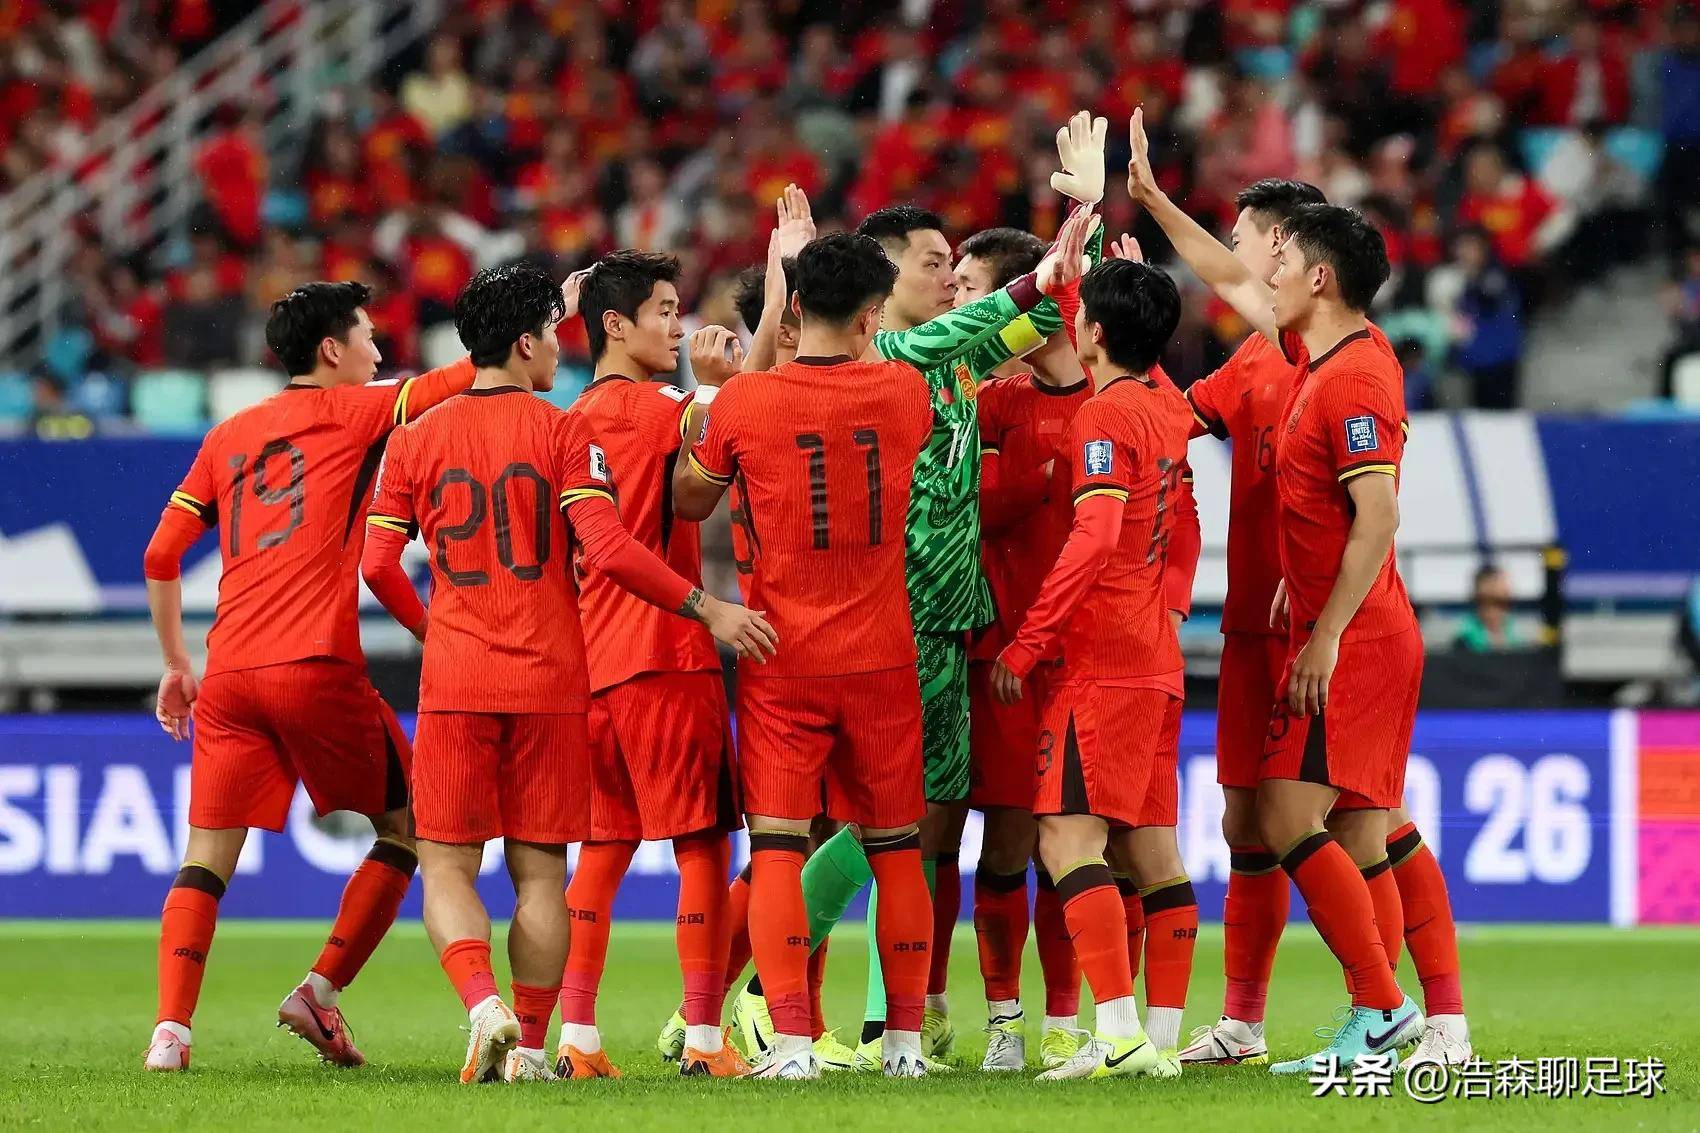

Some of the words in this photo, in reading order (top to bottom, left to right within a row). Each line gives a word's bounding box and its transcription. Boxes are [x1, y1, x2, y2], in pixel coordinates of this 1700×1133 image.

[228, 438, 304, 558] 19
[430, 462, 551, 587] 20
[795, 428, 884, 550] 11
[1464, 753, 1593, 884] 26
